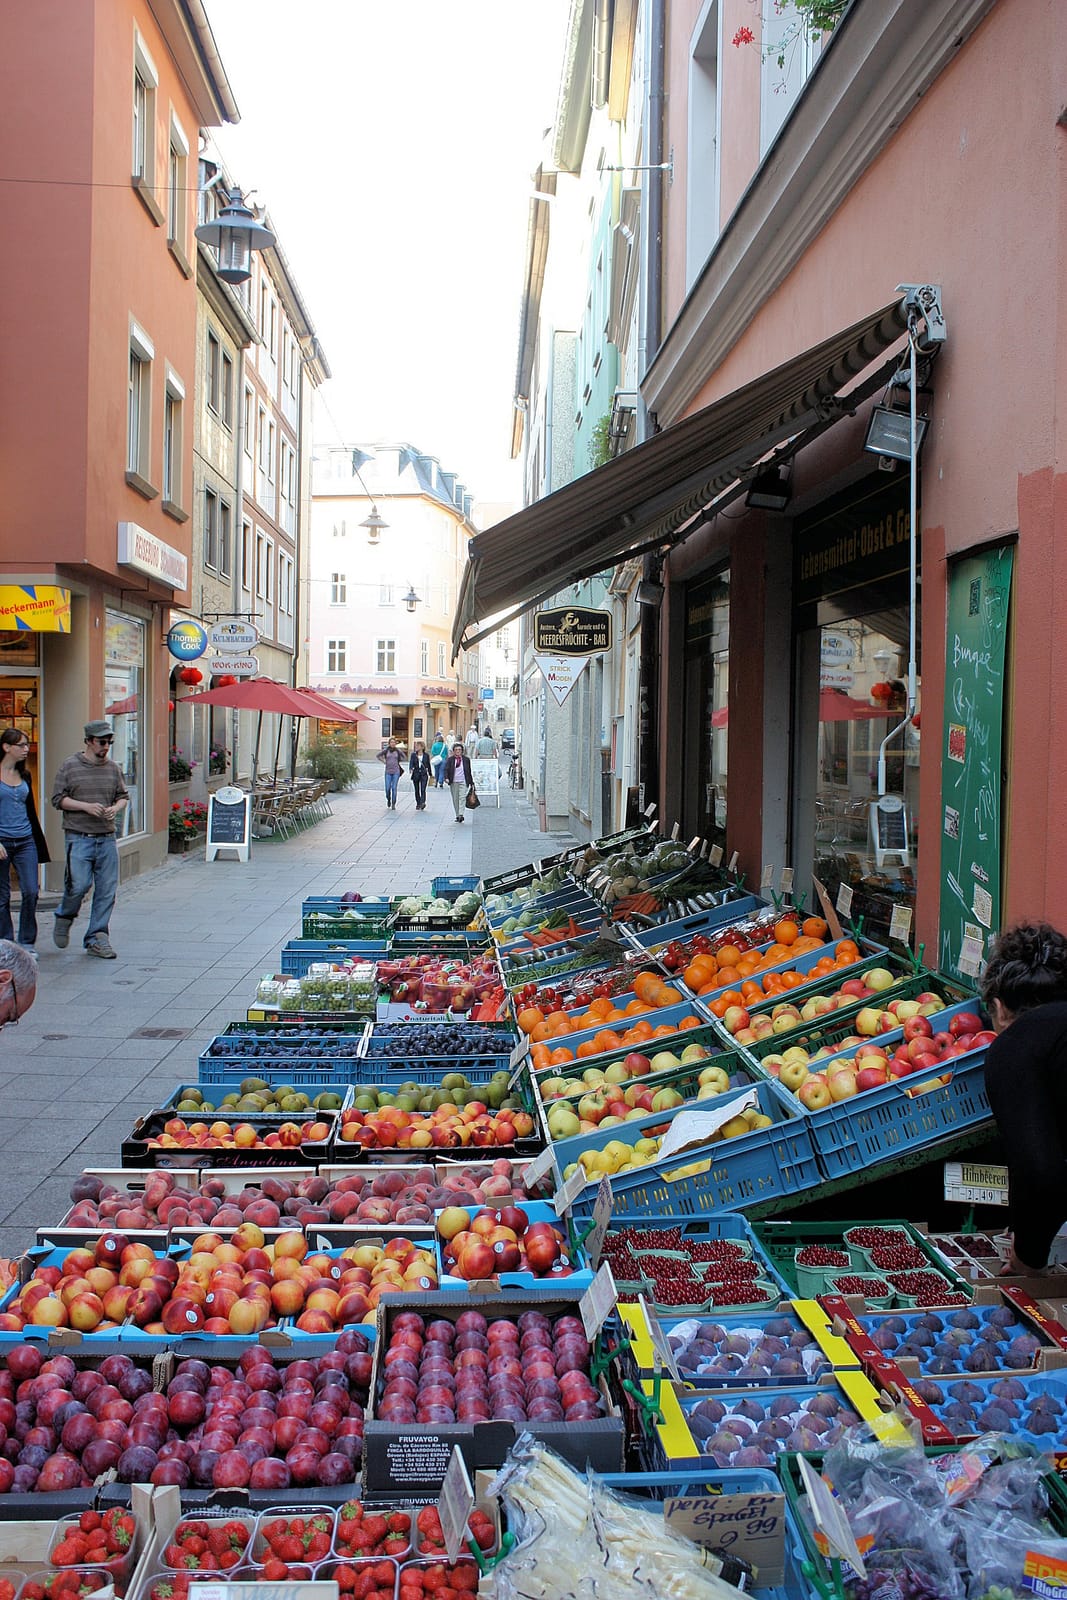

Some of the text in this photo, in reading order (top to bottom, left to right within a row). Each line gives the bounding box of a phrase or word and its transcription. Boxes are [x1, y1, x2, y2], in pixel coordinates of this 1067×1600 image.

[886, 513, 895, 547] &
[169, 633, 202, 642] Thomas
[593, 633, 607, 646] BAR
[181, 641, 201, 650] Cook
[216, 1154, 298, 1166] Angelina
[962, 1167, 1006, 1185] Himbeeren
